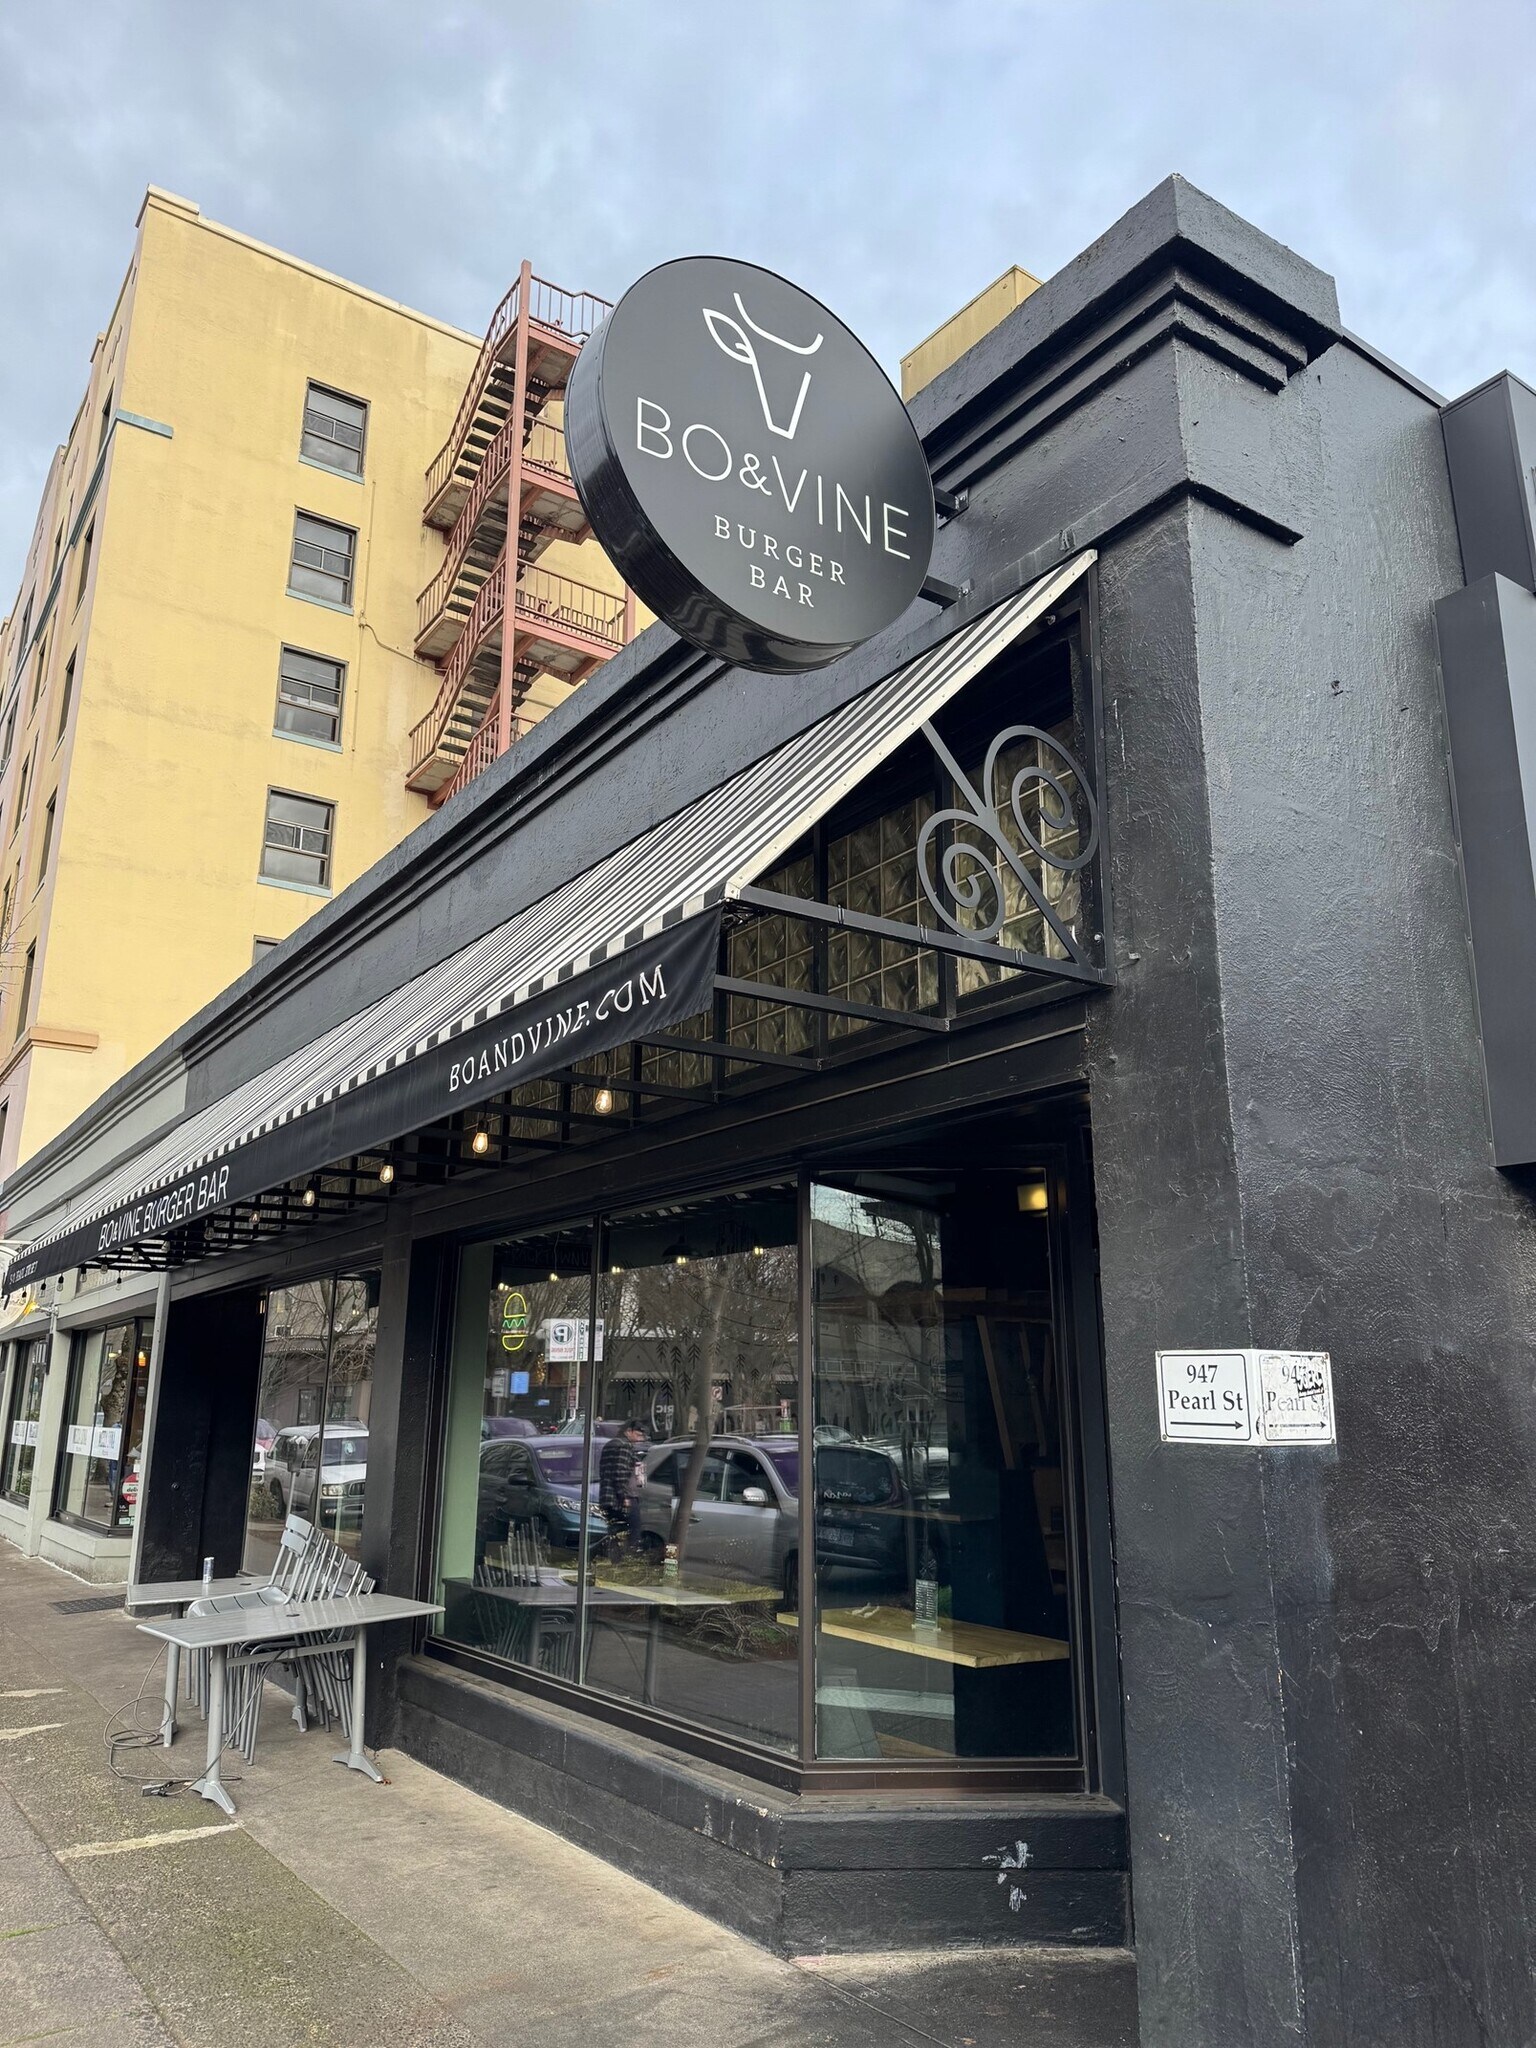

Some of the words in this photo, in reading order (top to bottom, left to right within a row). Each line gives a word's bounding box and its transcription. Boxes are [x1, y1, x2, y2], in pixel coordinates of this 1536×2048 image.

[637, 397, 911, 560] BO&VINE
[714, 514, 846, 585] BURGER
[749, 564, 815, 608] BAR
[449, 964, 667, 1092] BOANDVINE.COM
[98, 1205, 144, 1251] BO&VINE
[143, 1181, 195, 1232] BURGER
[196, 1164, 230, 1212] BAR
[1168, 1390, 1216, 1411] Pearl
[1223, 1390, 1244, 1411] St
[1186, 1364, 1218, 1383] 947
